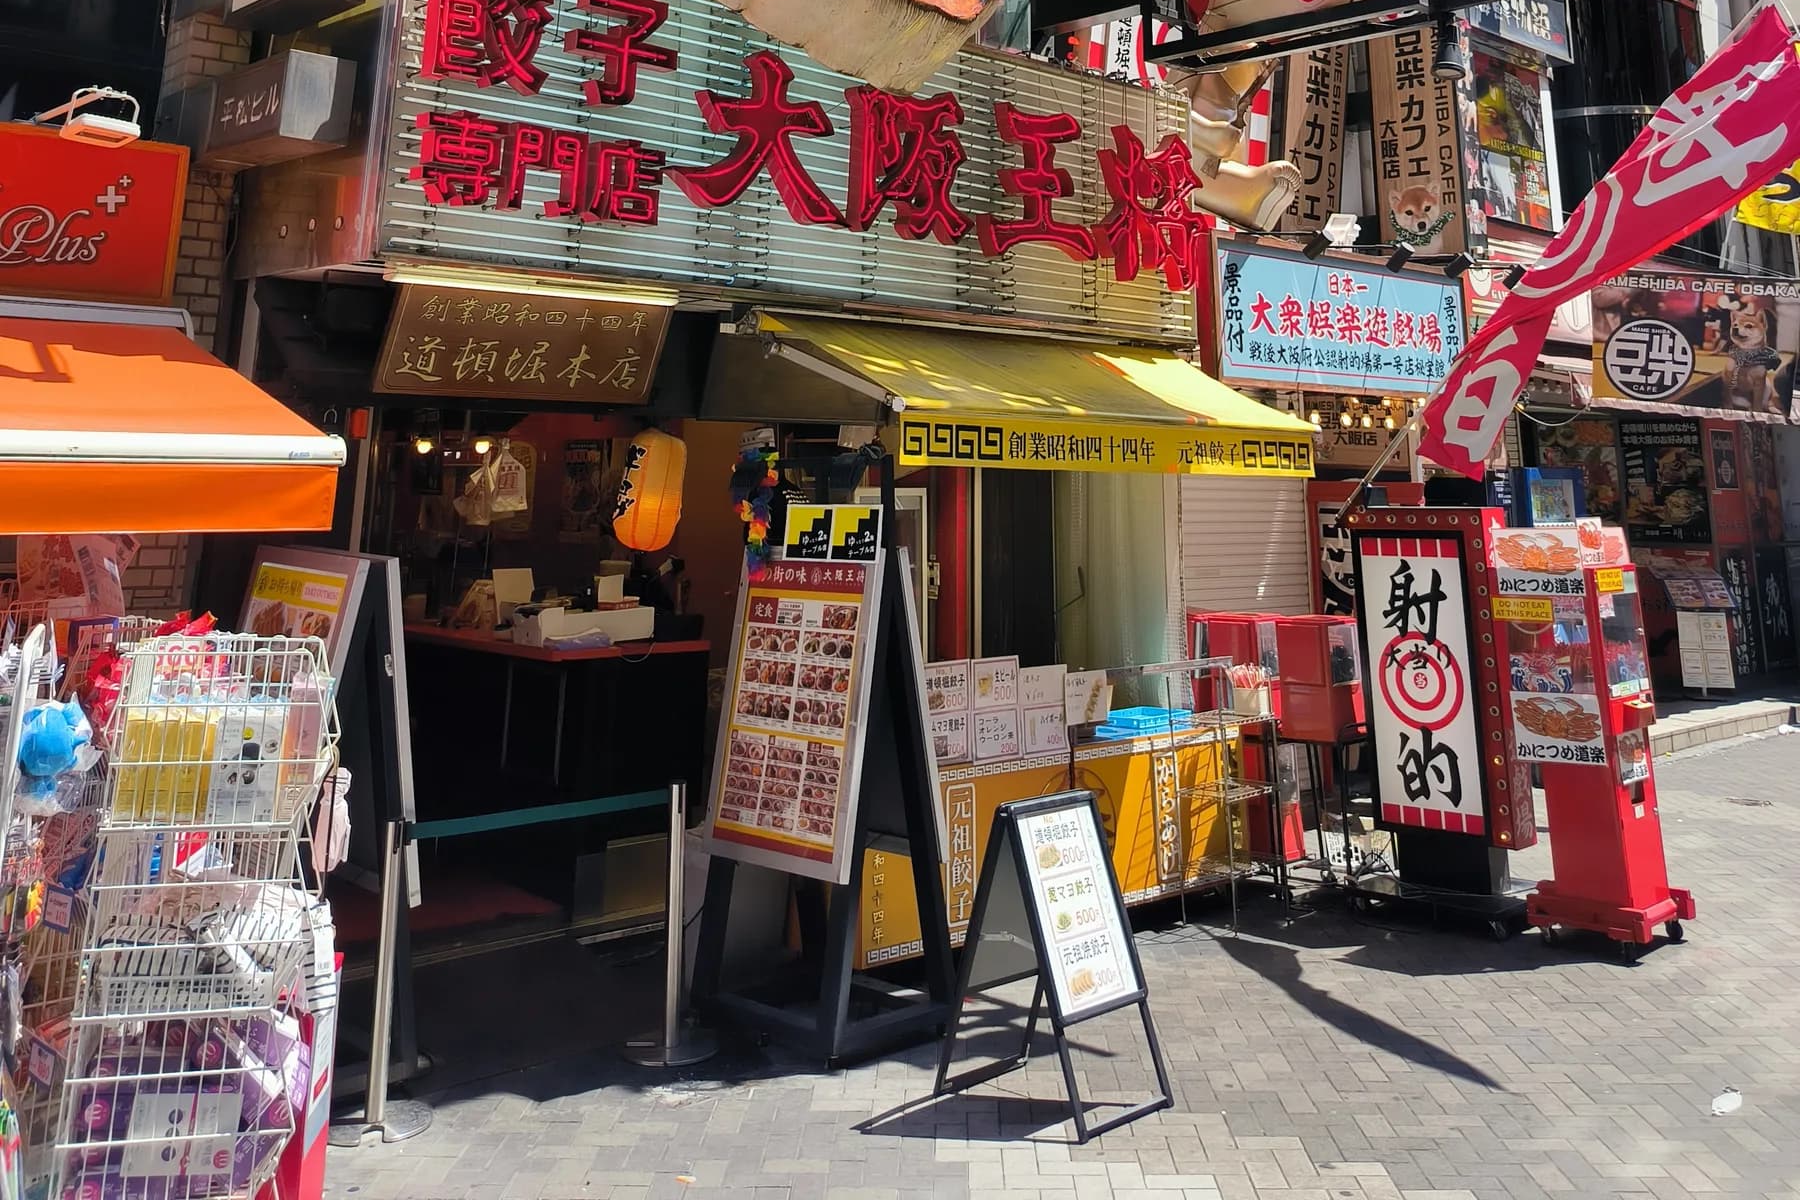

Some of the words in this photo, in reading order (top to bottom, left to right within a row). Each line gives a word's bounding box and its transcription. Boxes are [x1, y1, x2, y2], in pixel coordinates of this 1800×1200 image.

[408, 108, 669, 228] 専門店
[1379, 120, 1401, 180] 大阪店
[667, 51, 1204, 293] 大阪王将
[1439, 145, 1457, 205] CAFE
[0, 205, 105, 264] Plus
[1328, 273, 1369, 298] 日本一
[1692, 282, 1736, 294] CAFE
[1741, 284, 1799, 298] OSAKA
[419, 294, 649, 338] 創業昭和四十四年
[1223, 263, 1245, 354] 景品付
[395, 335, 642, 390] 道頓堀本店
[1632, 385, 1658, 393] CAFE
[1007, 430, 1156, 465] 創業昭和四十四年
[1176, 439, 1241, 467] 元祖餃子
[1333, 430, 1378, 446] 大阪店
[1498, 600, 1511, 609] DO
[1513, 600, 1531, 609] NOT
[1532, 601, 1546, 609] EAT
[1499, 577, 1585, 595] かにつめ道楽
[1526, 611, 1550, 619] PLACE
[1383, 643, 1453, 672] 大当り
[1517, 741, 1606, 764] かにつめ道楽
[950, 791, 975, 922] 元祖餃子
